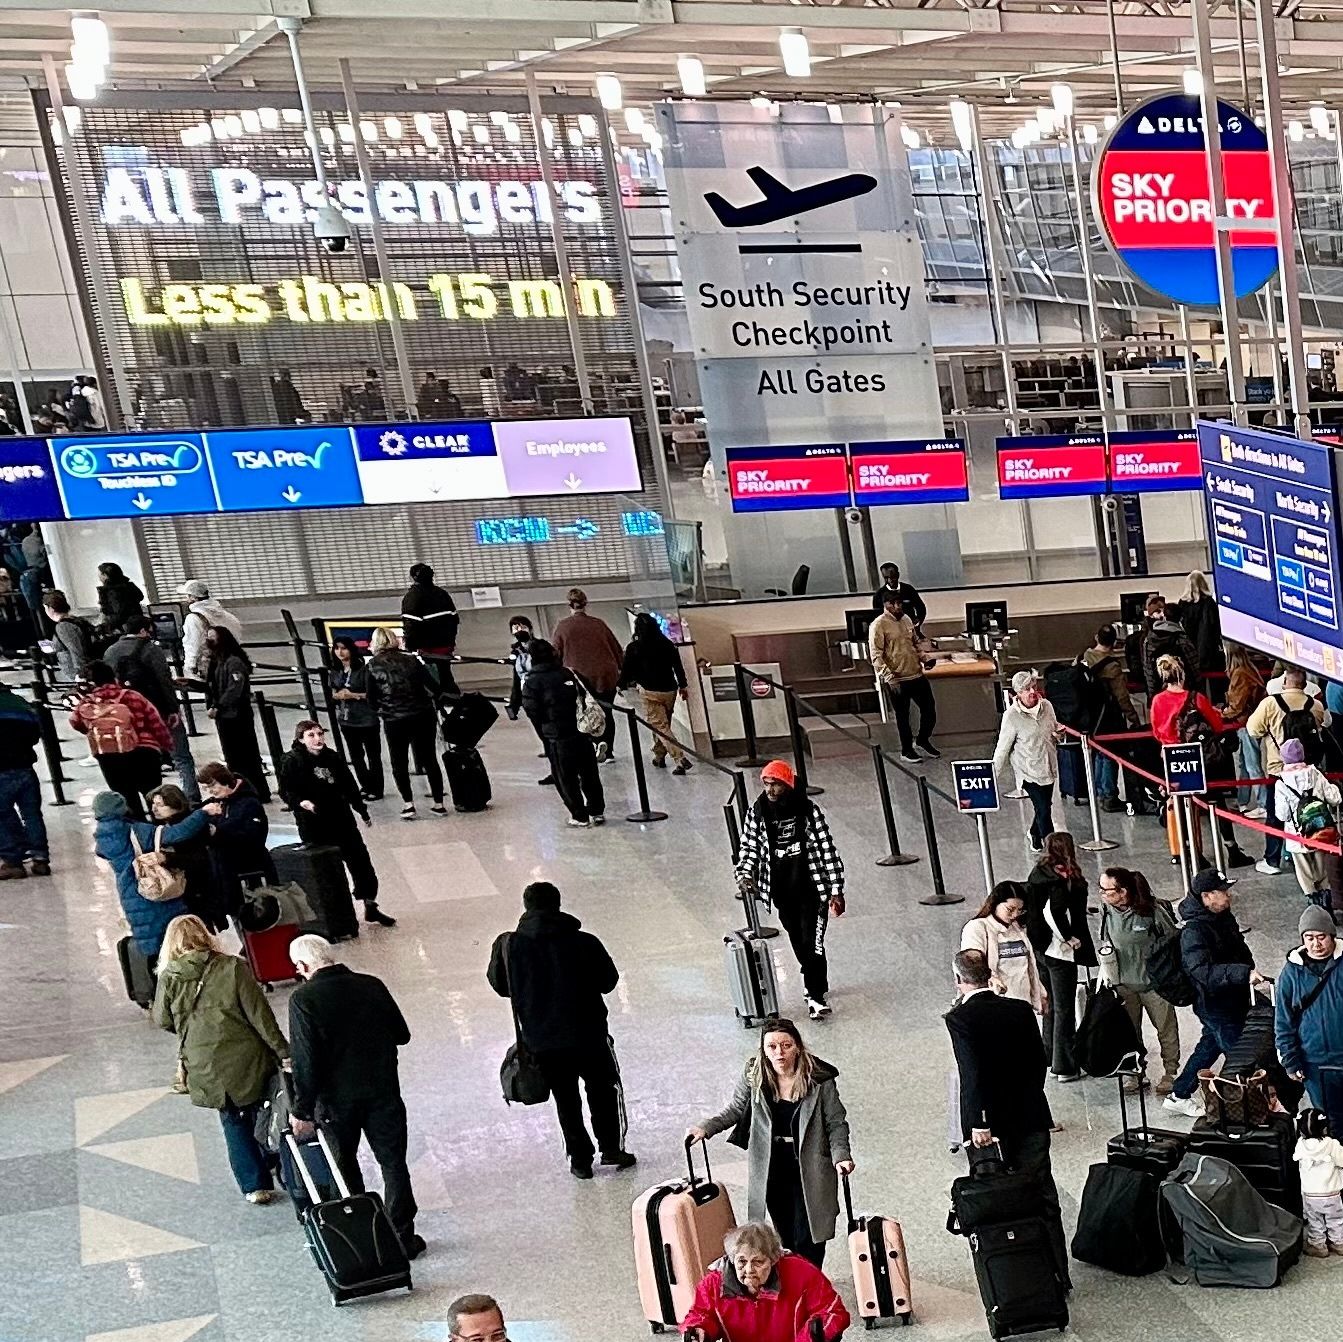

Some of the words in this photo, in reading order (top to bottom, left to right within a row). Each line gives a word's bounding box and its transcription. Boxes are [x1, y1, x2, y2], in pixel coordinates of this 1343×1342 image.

[1156, 116, 1224, 134] DELT
[1111, 172, 1175, 200] SKY
[101, 166, 205, 225] All
[213, 167, 601, 235] Passengers
[1113, 197, 1265, 223] PRIORTY
[124, 278, 268, 326] Less
[280, 275, 417, 323] than
[431, 272, 497, 320] 15
[699, 282, 785, 309] South
[793, 281, 912, 311] Security
[731, 320, 893, 352] Checkpoint
[757, 369, 796, 396] All
[804, 368, 887, 394] Gates
[526, 440, 607, 457] Employees
[107, 453, 138, 468] TSA
[232, 451, 271, 469] TSA
[1004, 458, 1034, 473] SKY
[1115, 453, 1144, 467] SKY
[859, 465, 889, 476] SKY
[1006, 467, 1072, 480] PRIORITY
[1117, 461, 1181, 475] PRIORITY
[736, 469, 769, 483] SKY
[860, 473, 930, 487] PRIORITY
[738, 478, 811, 492] PRIORITY
[1170, 761, 1198, 773] EXIT
[961, 777, 991, 790] EXIT
